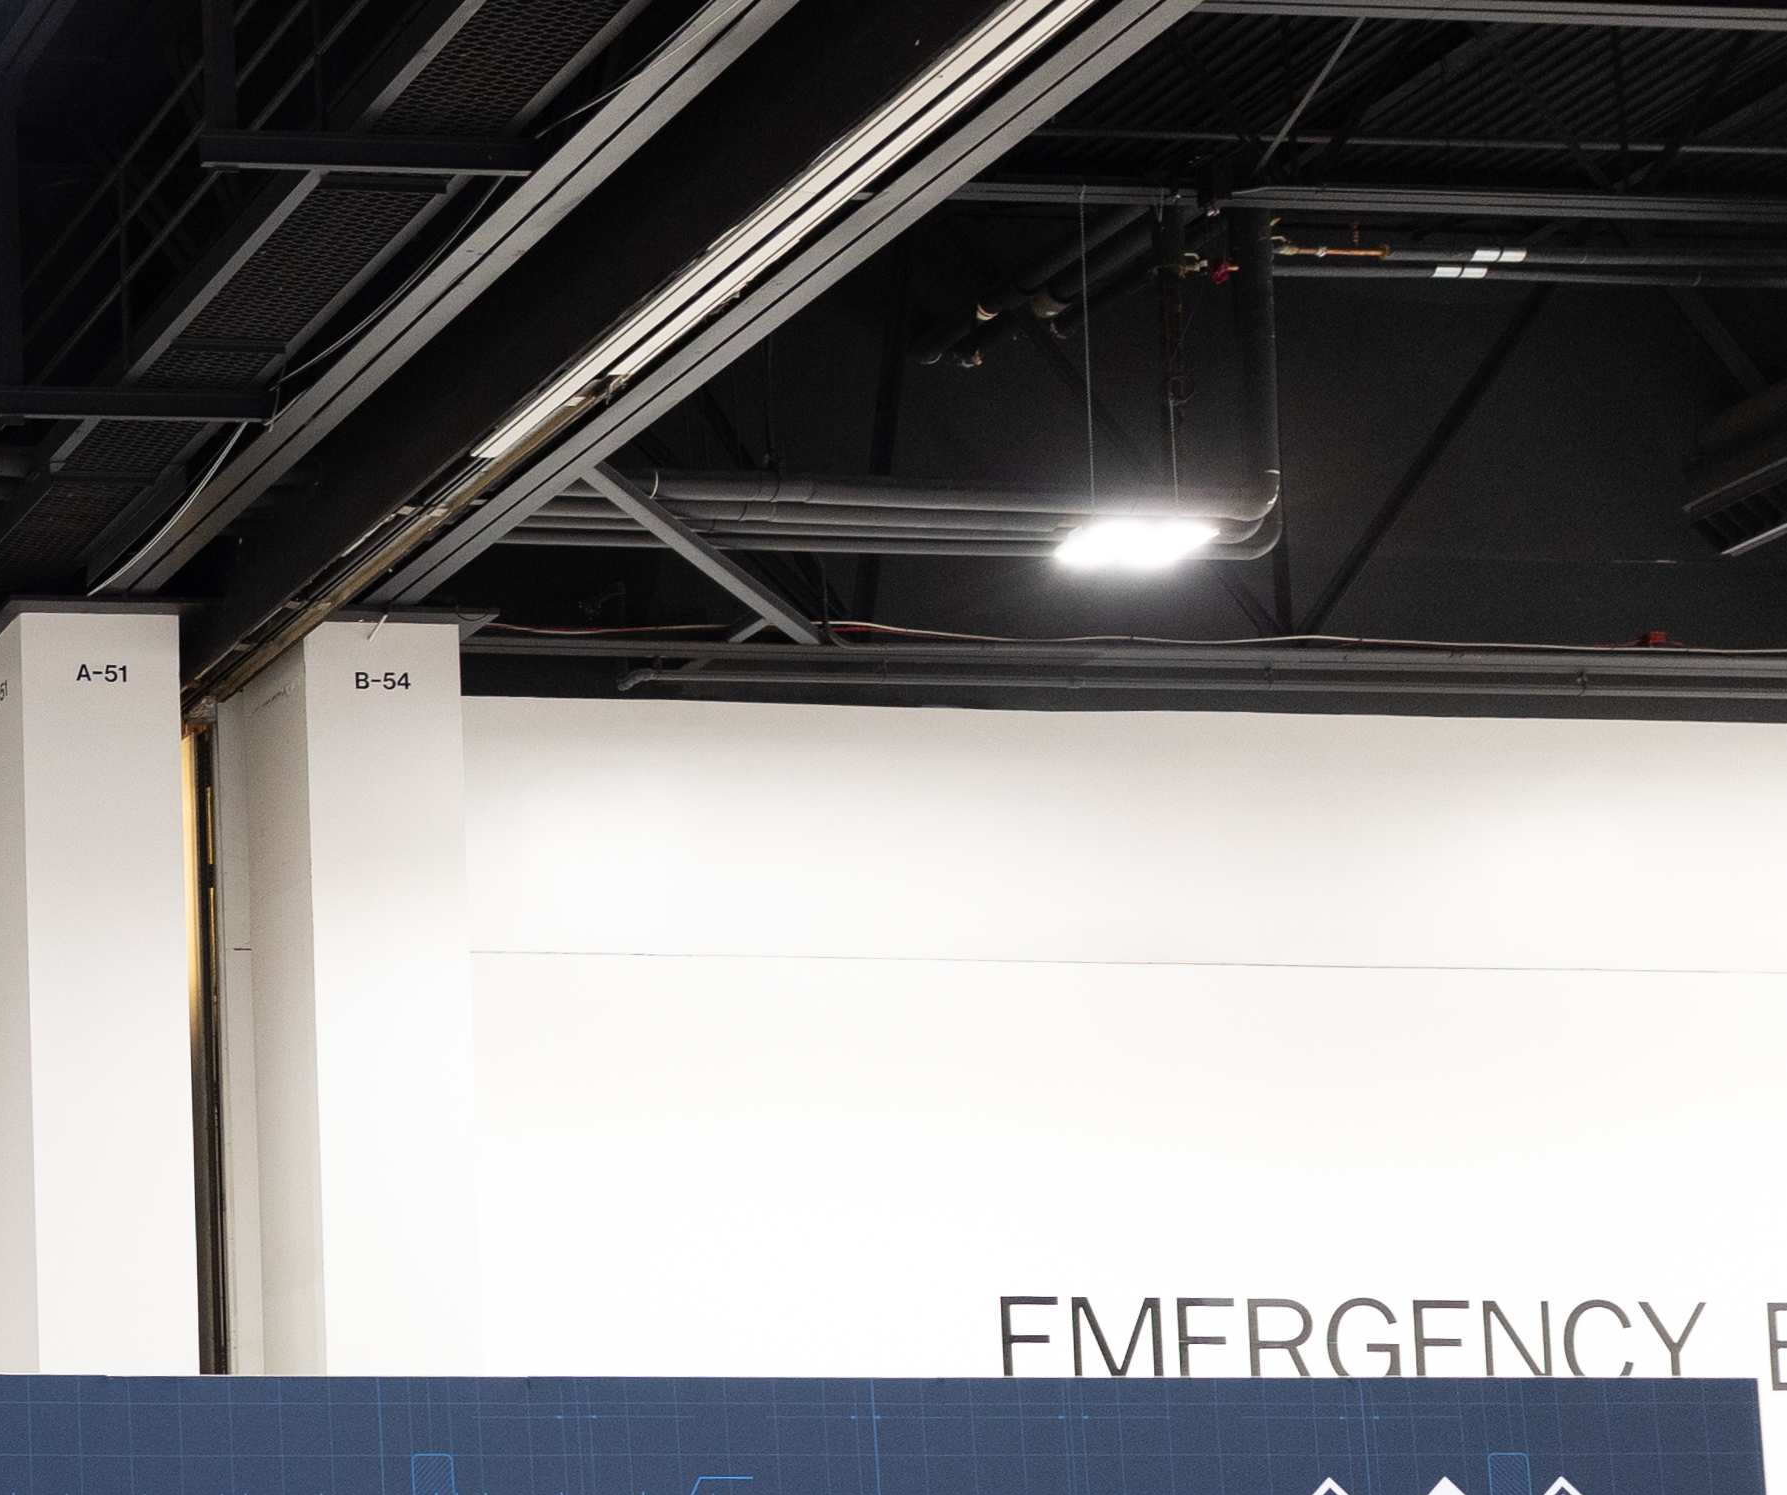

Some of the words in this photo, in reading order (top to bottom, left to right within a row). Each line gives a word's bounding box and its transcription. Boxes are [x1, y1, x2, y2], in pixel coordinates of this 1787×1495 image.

[76, 664, 128, 683] A-51
[354, 671, 412, 690] B-54
[998, 1295, 1707, 1378] EMERGENCY
